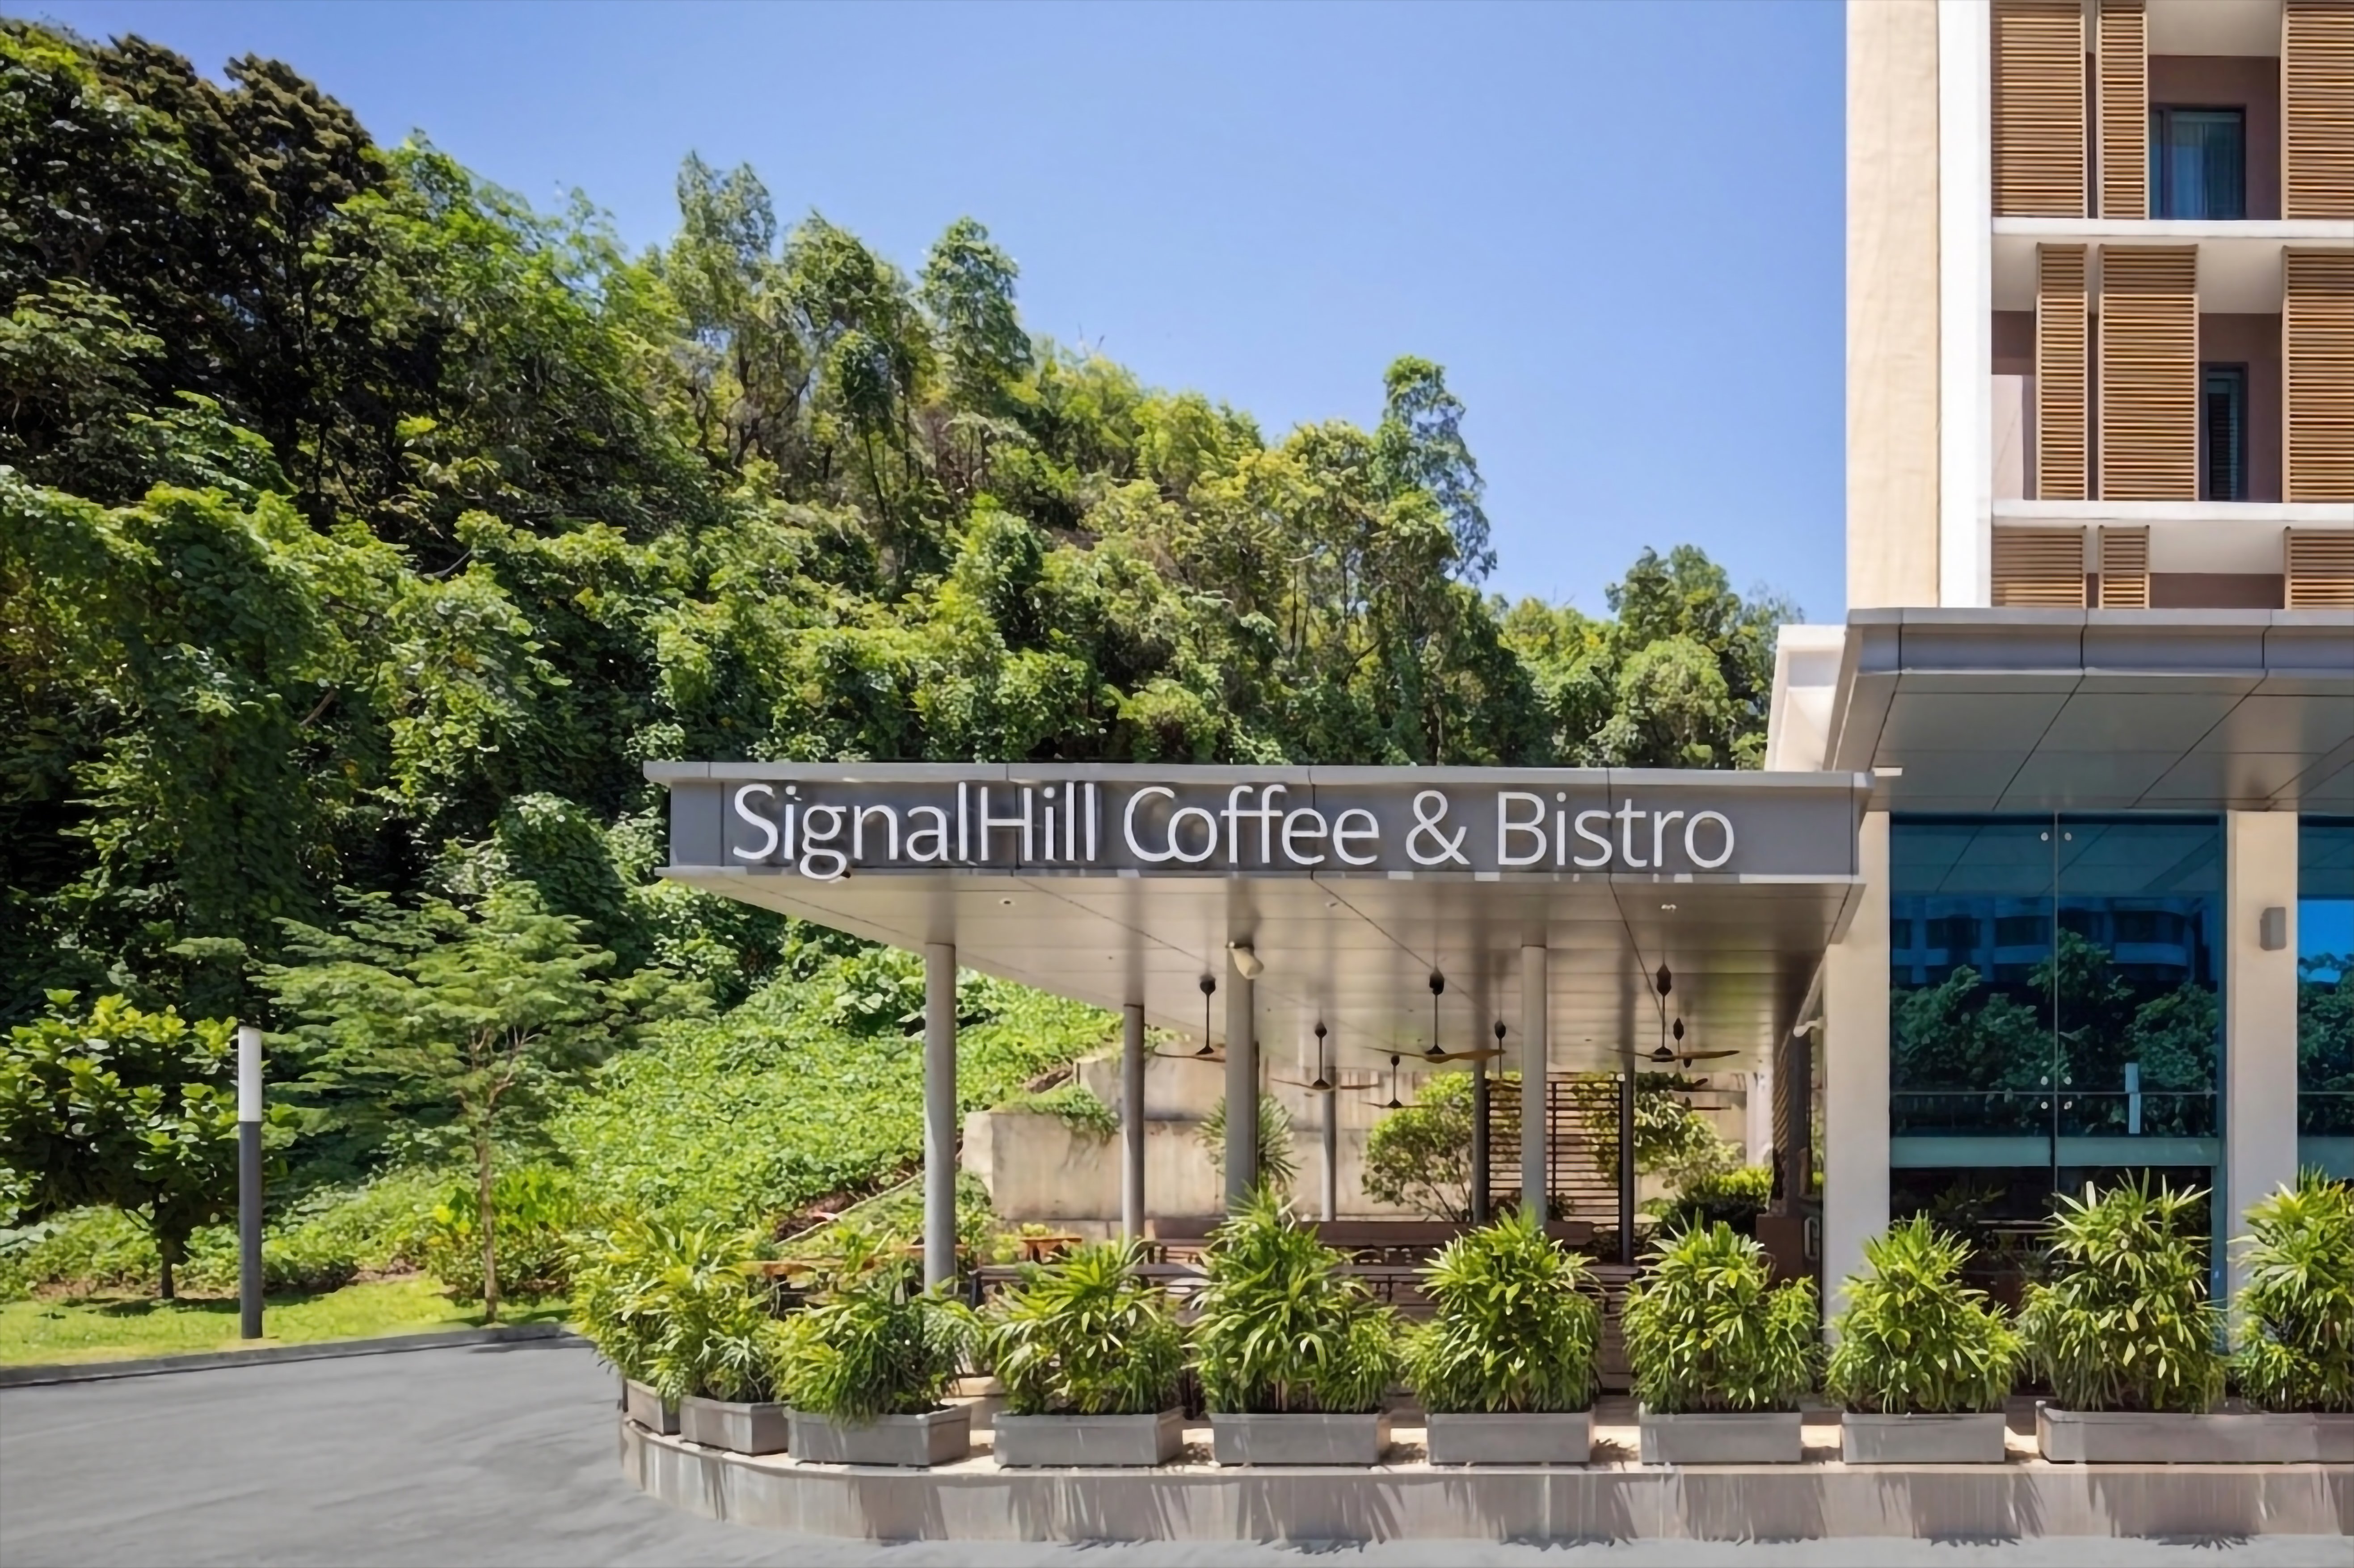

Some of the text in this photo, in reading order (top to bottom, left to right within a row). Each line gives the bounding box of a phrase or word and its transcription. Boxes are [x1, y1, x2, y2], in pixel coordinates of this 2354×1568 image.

[733, 782, 1735, 881] SignalHill Coffee & Bistro
